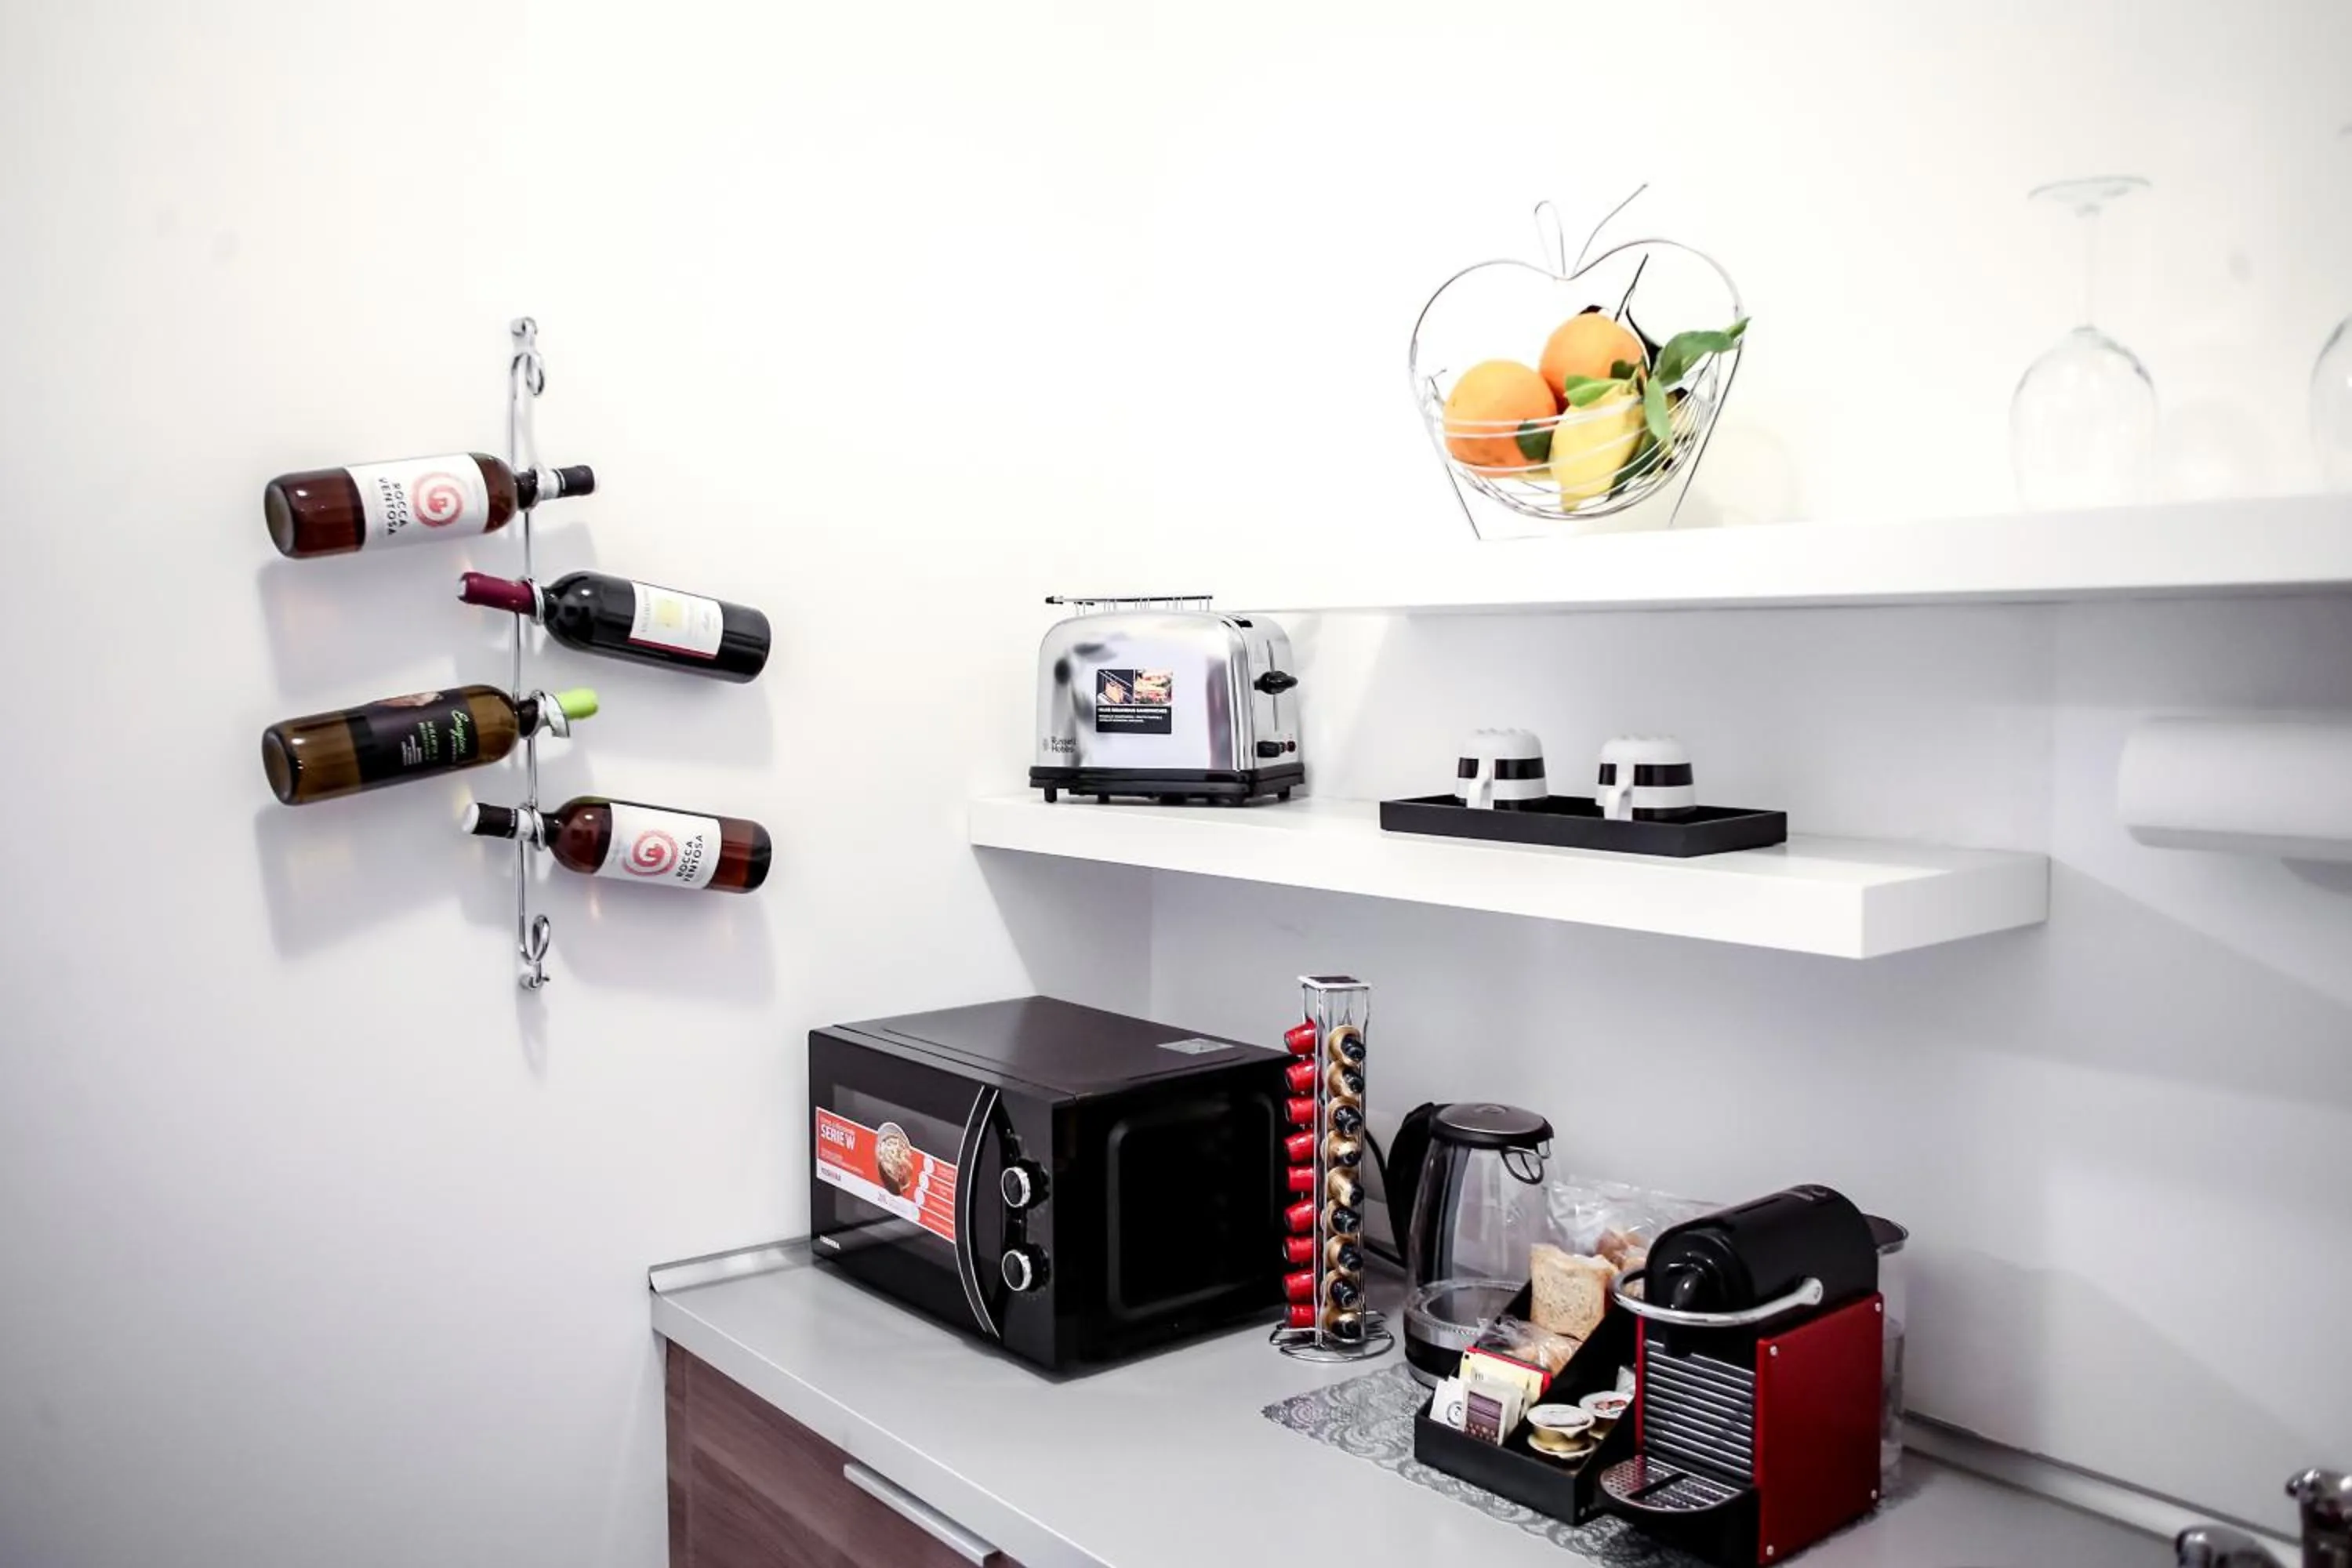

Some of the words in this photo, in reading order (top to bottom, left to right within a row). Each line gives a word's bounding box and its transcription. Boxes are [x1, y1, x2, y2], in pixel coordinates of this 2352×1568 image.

[379, 477, 397, 535] VENTOSA
[392, 482, 408, 528] ROCCA
[676, 840, 693, 877] ROCCA
[683, 834, 703, 882] VENTOSA
[820, 1123, 845, 1148] SERIE
